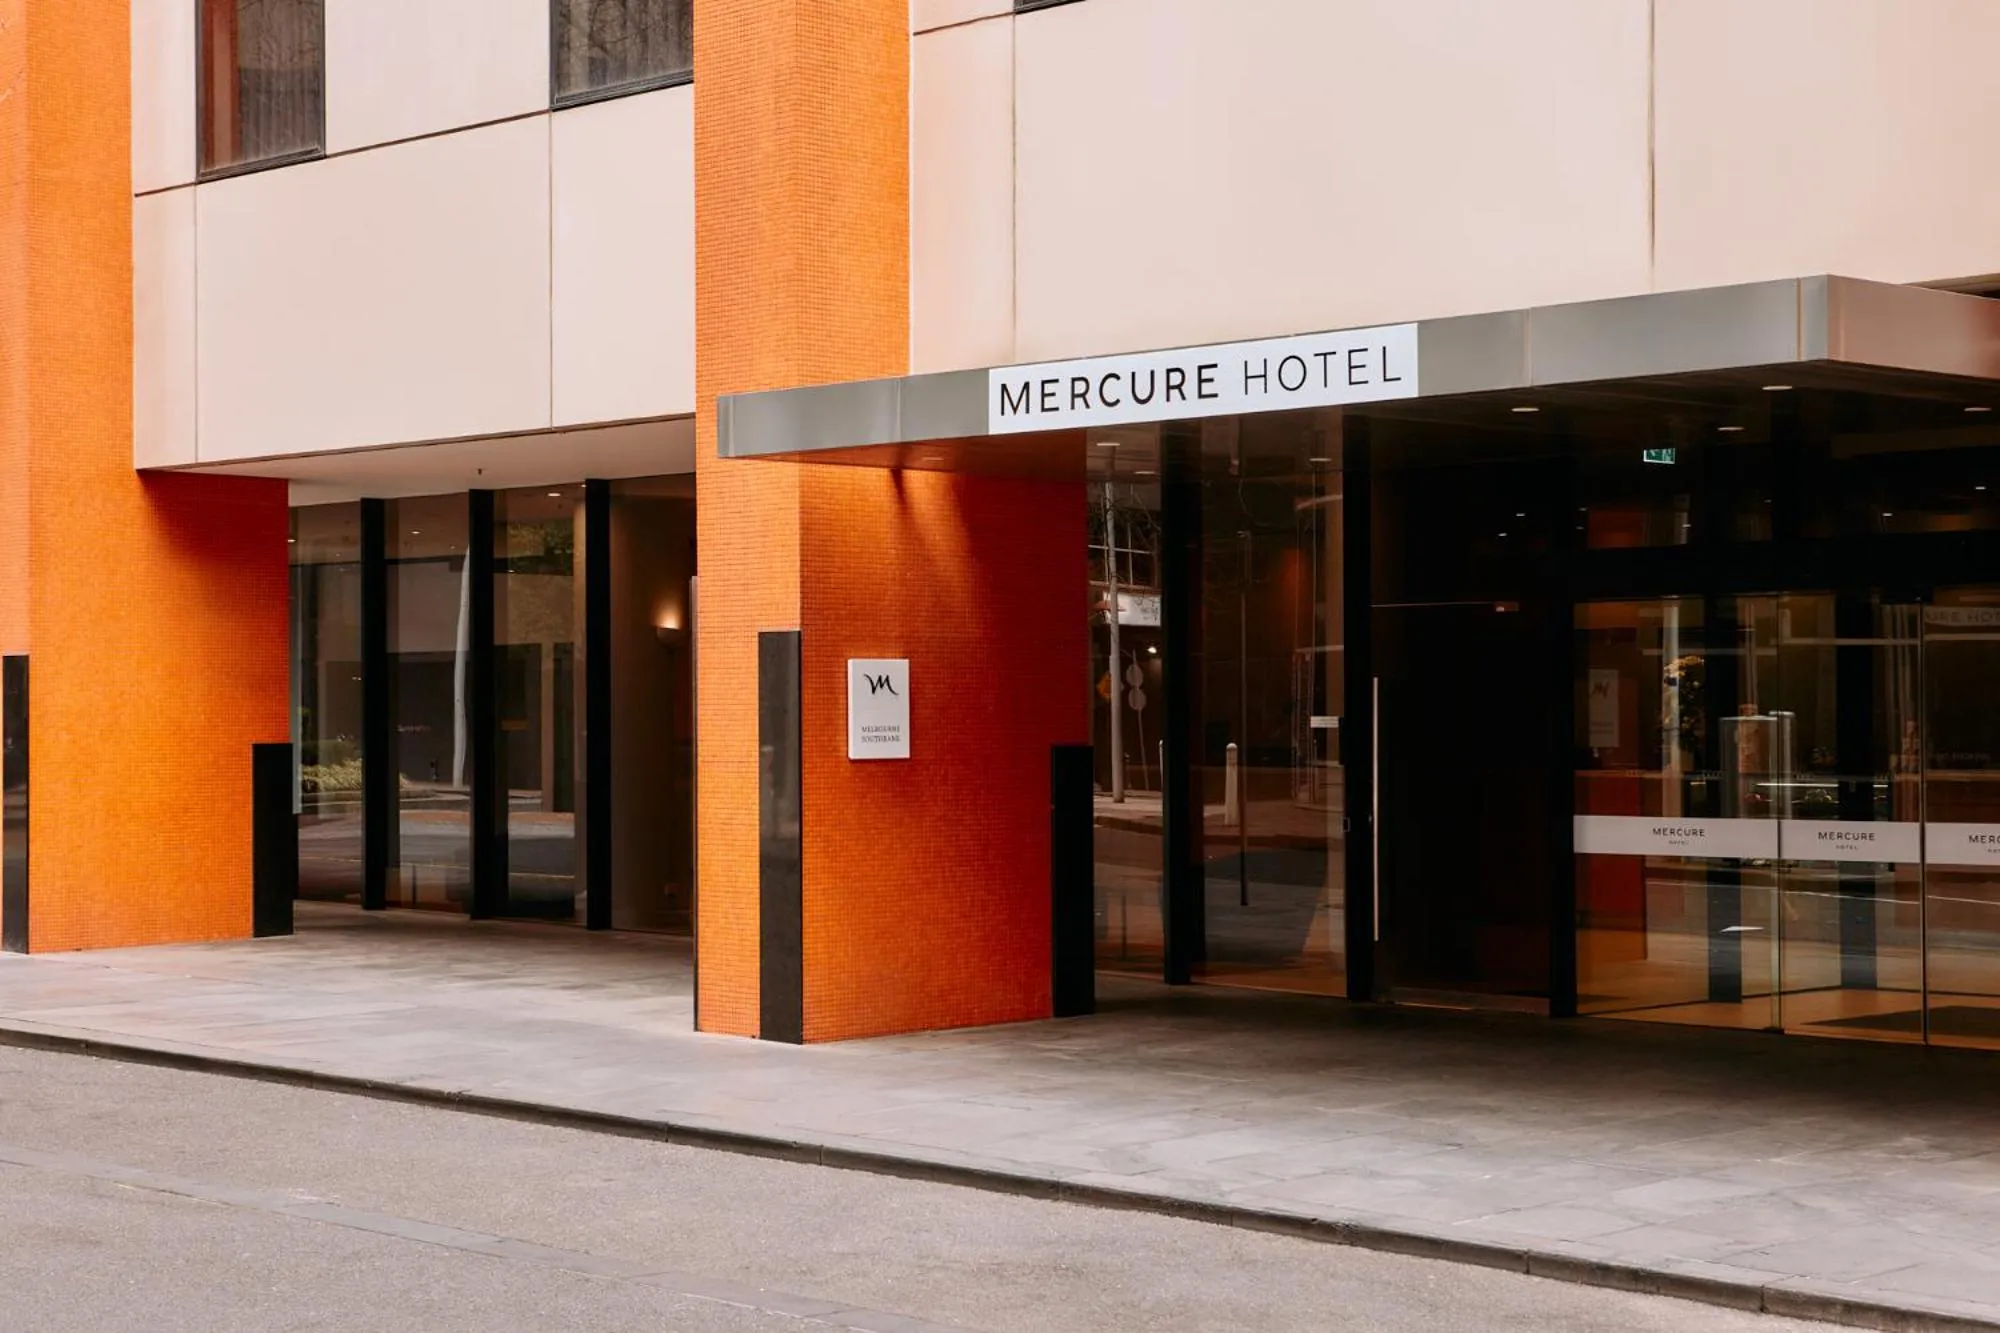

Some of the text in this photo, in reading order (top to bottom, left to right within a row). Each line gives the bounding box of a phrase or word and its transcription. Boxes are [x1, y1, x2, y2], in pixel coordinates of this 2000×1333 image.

[1000, 346, 1402, 417] MERCURE HOTEL
[1652, 827, 1705, 837] MERCURE
[1818, 831, 1875, 841] MERCURE
